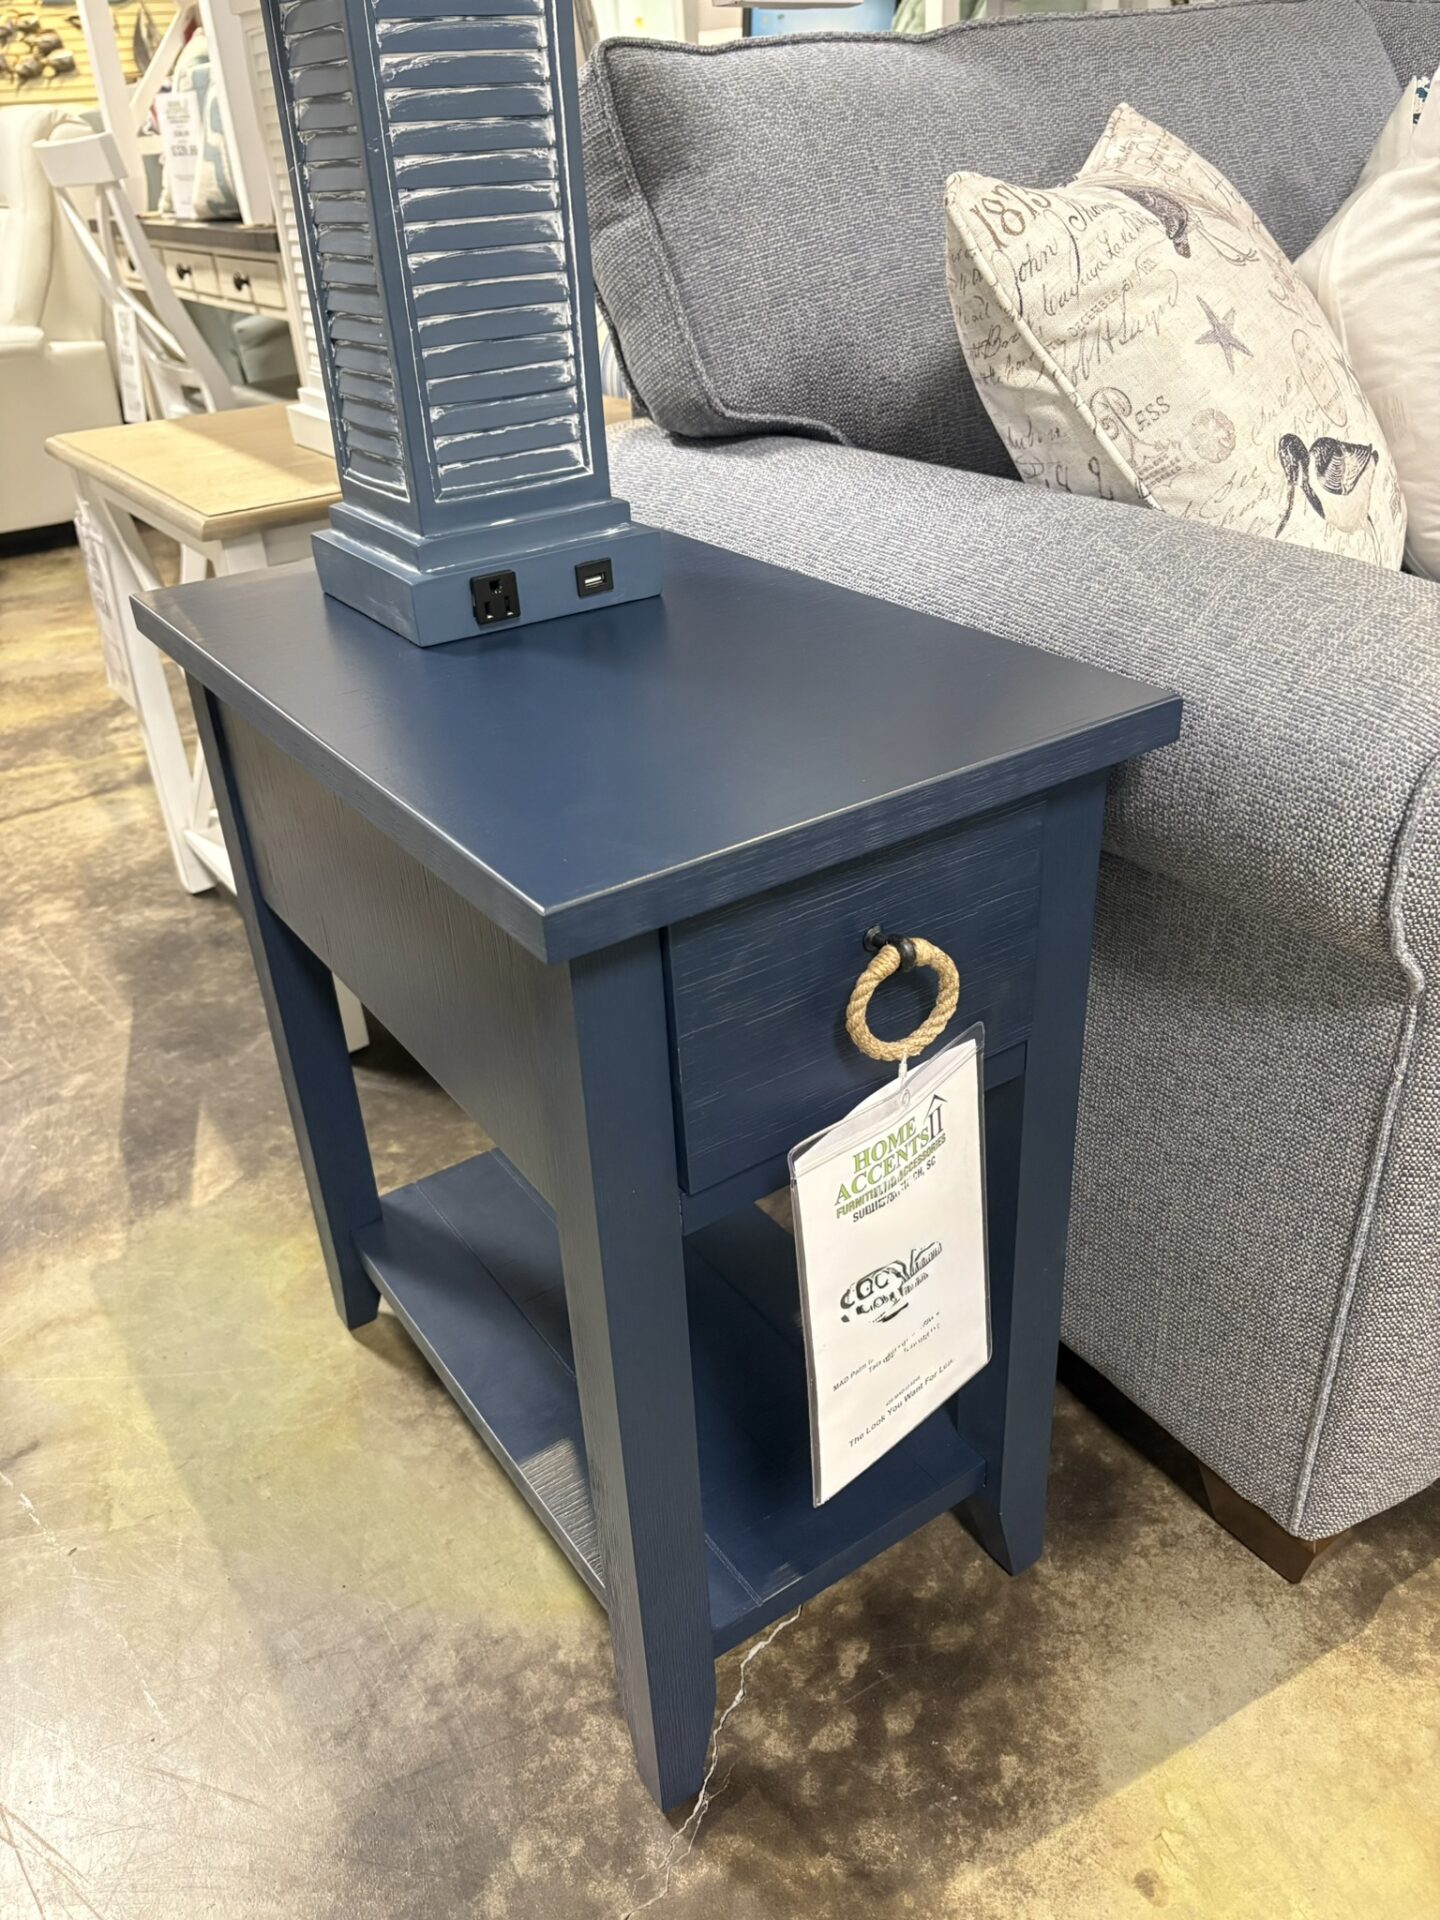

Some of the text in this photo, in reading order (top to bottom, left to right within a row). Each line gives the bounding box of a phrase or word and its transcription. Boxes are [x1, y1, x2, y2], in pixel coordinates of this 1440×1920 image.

[835, 1126, 930, 1206] ACCENTS
[853, 1116, 917, 1175] HOME
[848, 1432, 865, 1448] The
[865, 1414, 886, 1436] Look
[887, 1400, 903, 1416] You
[904, 1382, 924, 1403] Want
[924, 1371, 938, 1386] For
